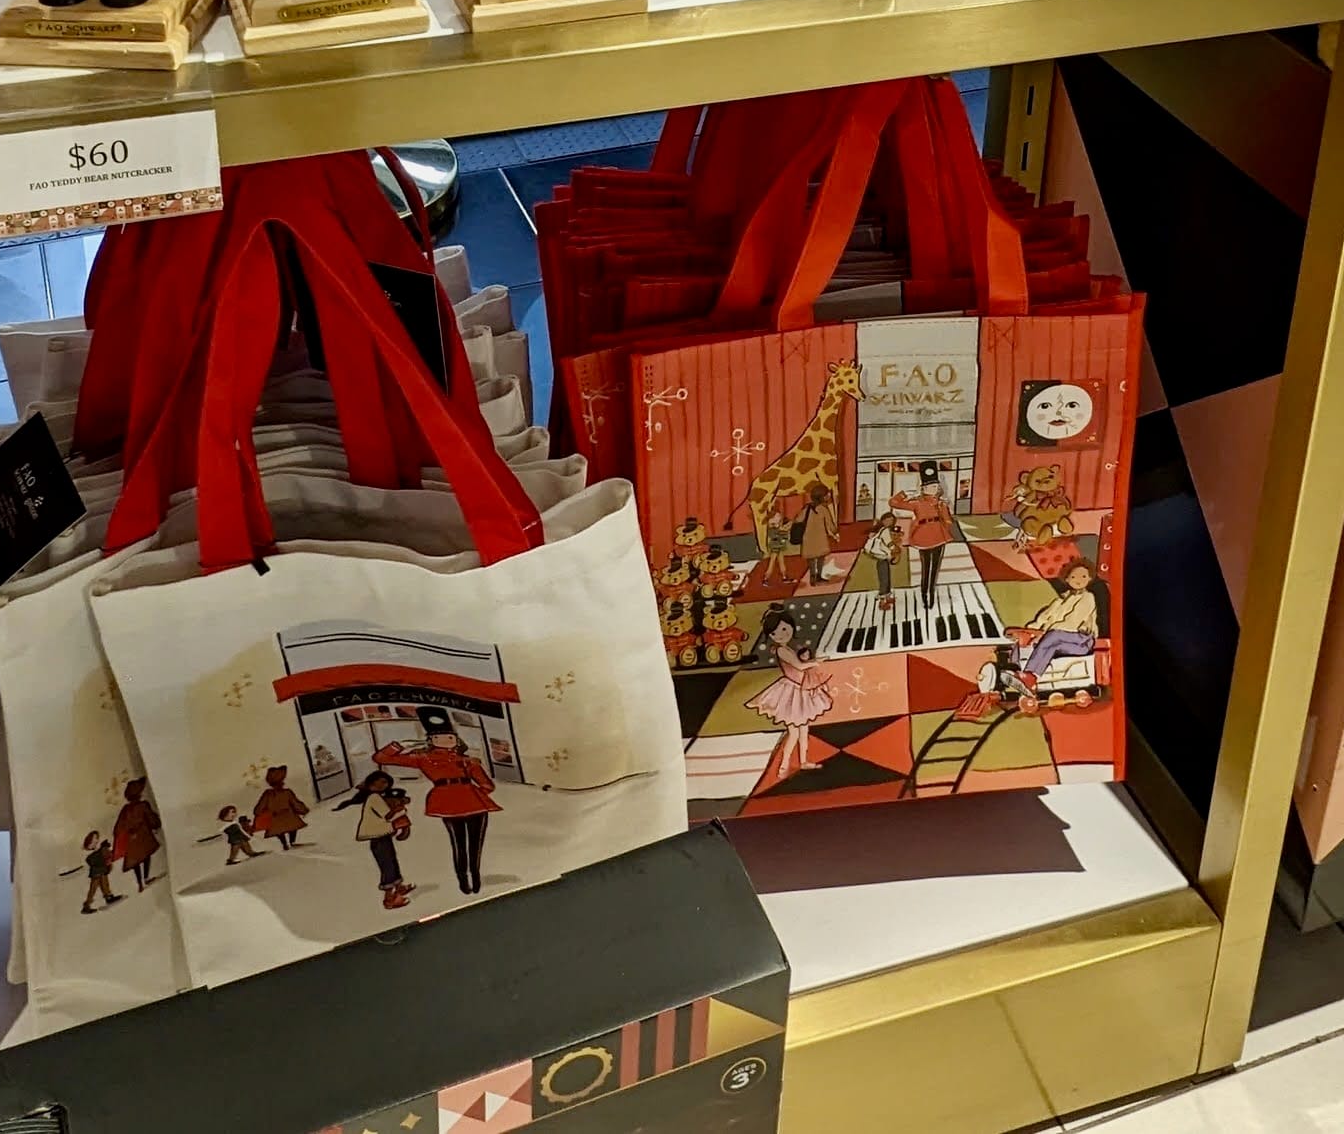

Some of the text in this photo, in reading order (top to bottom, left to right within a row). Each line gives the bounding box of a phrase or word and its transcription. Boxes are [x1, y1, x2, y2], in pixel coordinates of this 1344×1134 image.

[68, 139, 130, 171] $60
[29, 165, 173, 191] FAO TEDDY BEAR NUTCRACKER
[730, 1068, 758, 1089] 3+
